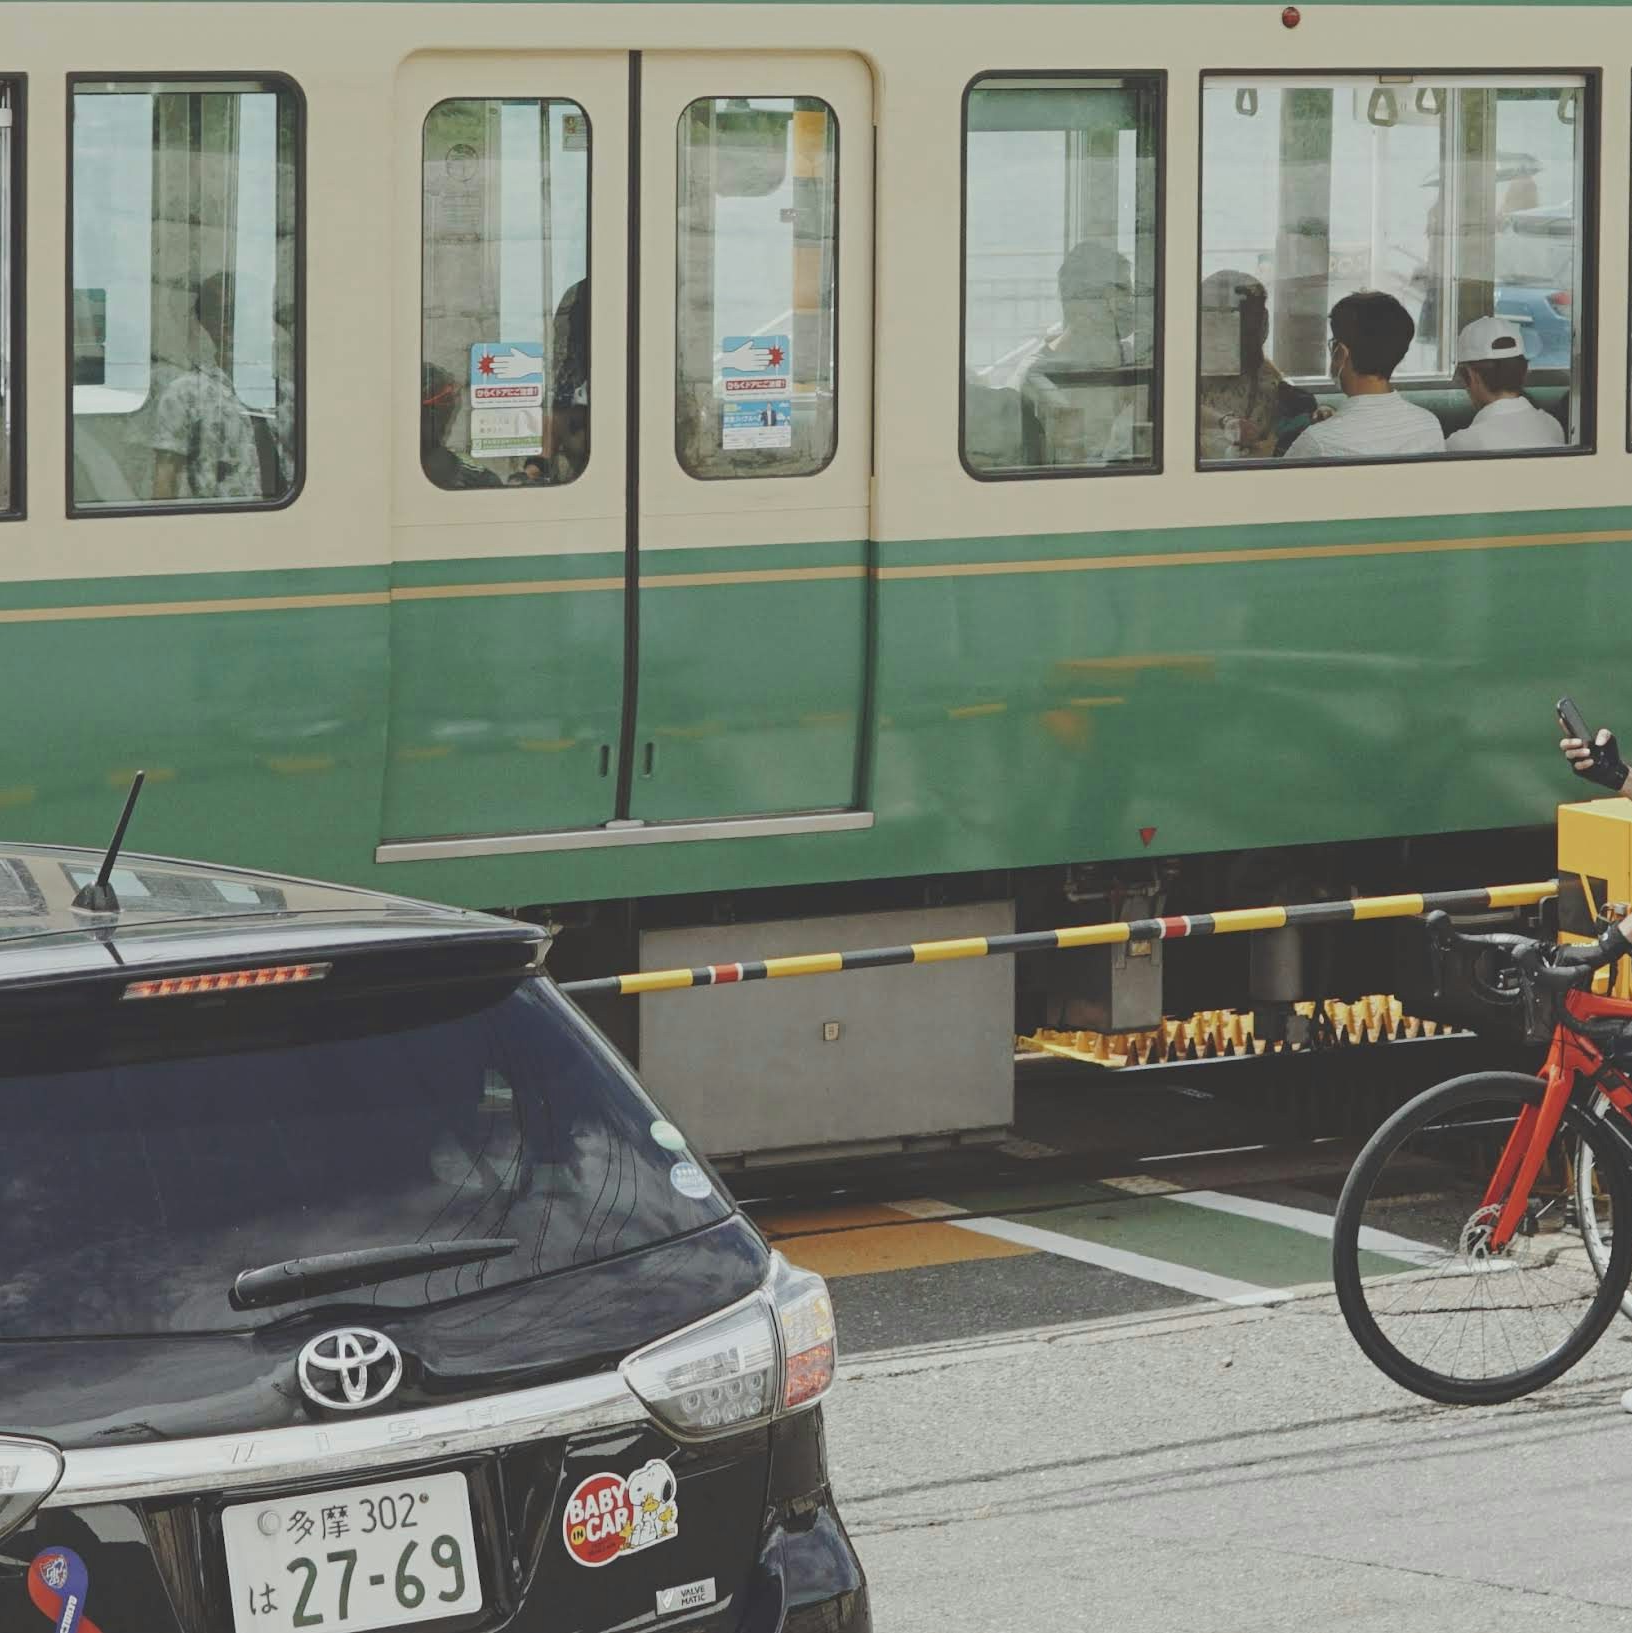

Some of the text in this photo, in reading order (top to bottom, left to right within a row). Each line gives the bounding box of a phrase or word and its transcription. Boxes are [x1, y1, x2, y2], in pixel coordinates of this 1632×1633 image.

[287, 1492, 418, 1545] 多摩 302
[568, 1485, 627, 1525] BABY
[572, 1507, 629, 1542] IN CAR
[249, 1534, 466, 1628] は 27-69
[680, 1584, 706, 1598] VALVE
[681, 1593, 707, 1606] MATIC
